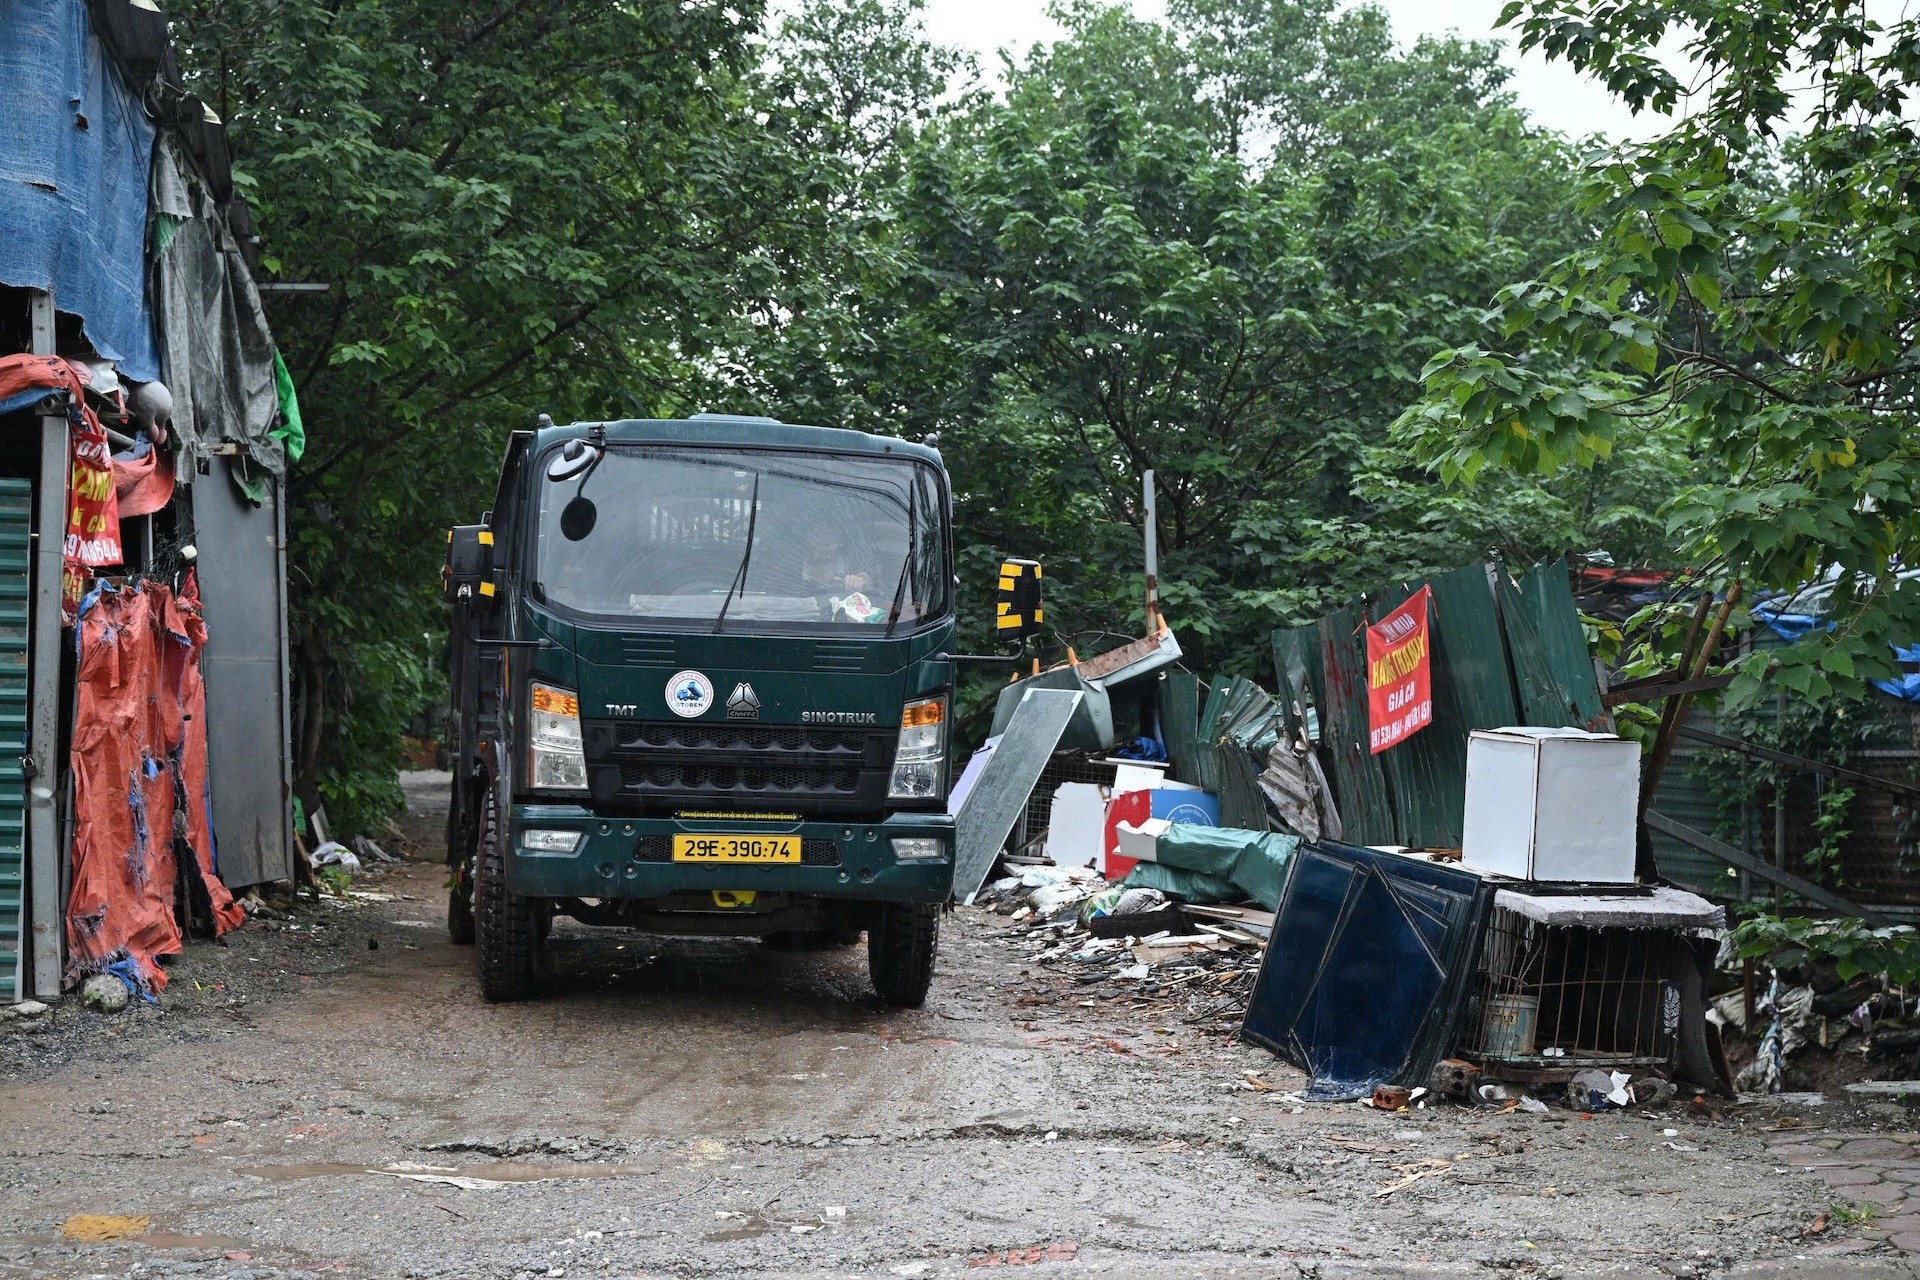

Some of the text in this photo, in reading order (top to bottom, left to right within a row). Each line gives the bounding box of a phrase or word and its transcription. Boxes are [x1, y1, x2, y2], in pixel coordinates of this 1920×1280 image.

[1388, 684, 1404, 713] GIÁ
[606, 704, 638, 717] TMT
[801, 710, 876, 724] SINOTRUK
